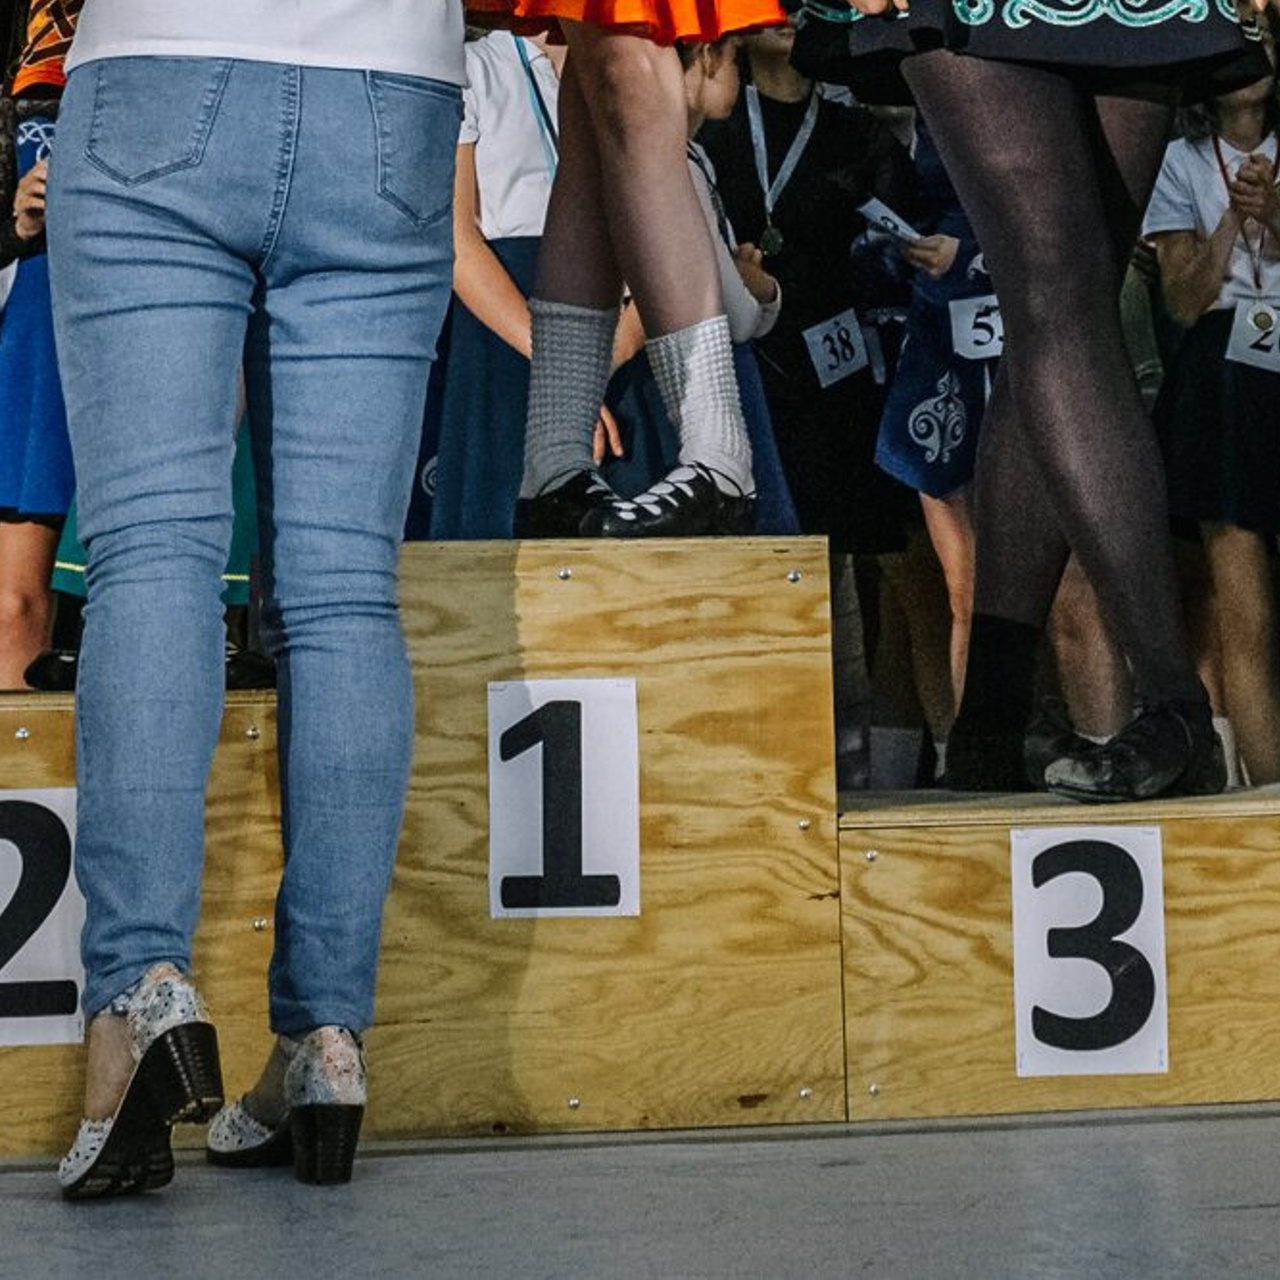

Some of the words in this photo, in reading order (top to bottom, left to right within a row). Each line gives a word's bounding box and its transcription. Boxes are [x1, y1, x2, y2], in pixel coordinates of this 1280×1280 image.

[822, 326, 855, 370] 38
[971, 305, 1004, 346] 5
[500, 700, 620, 908] 1
[1031, 839, 1157, 1052] 3
